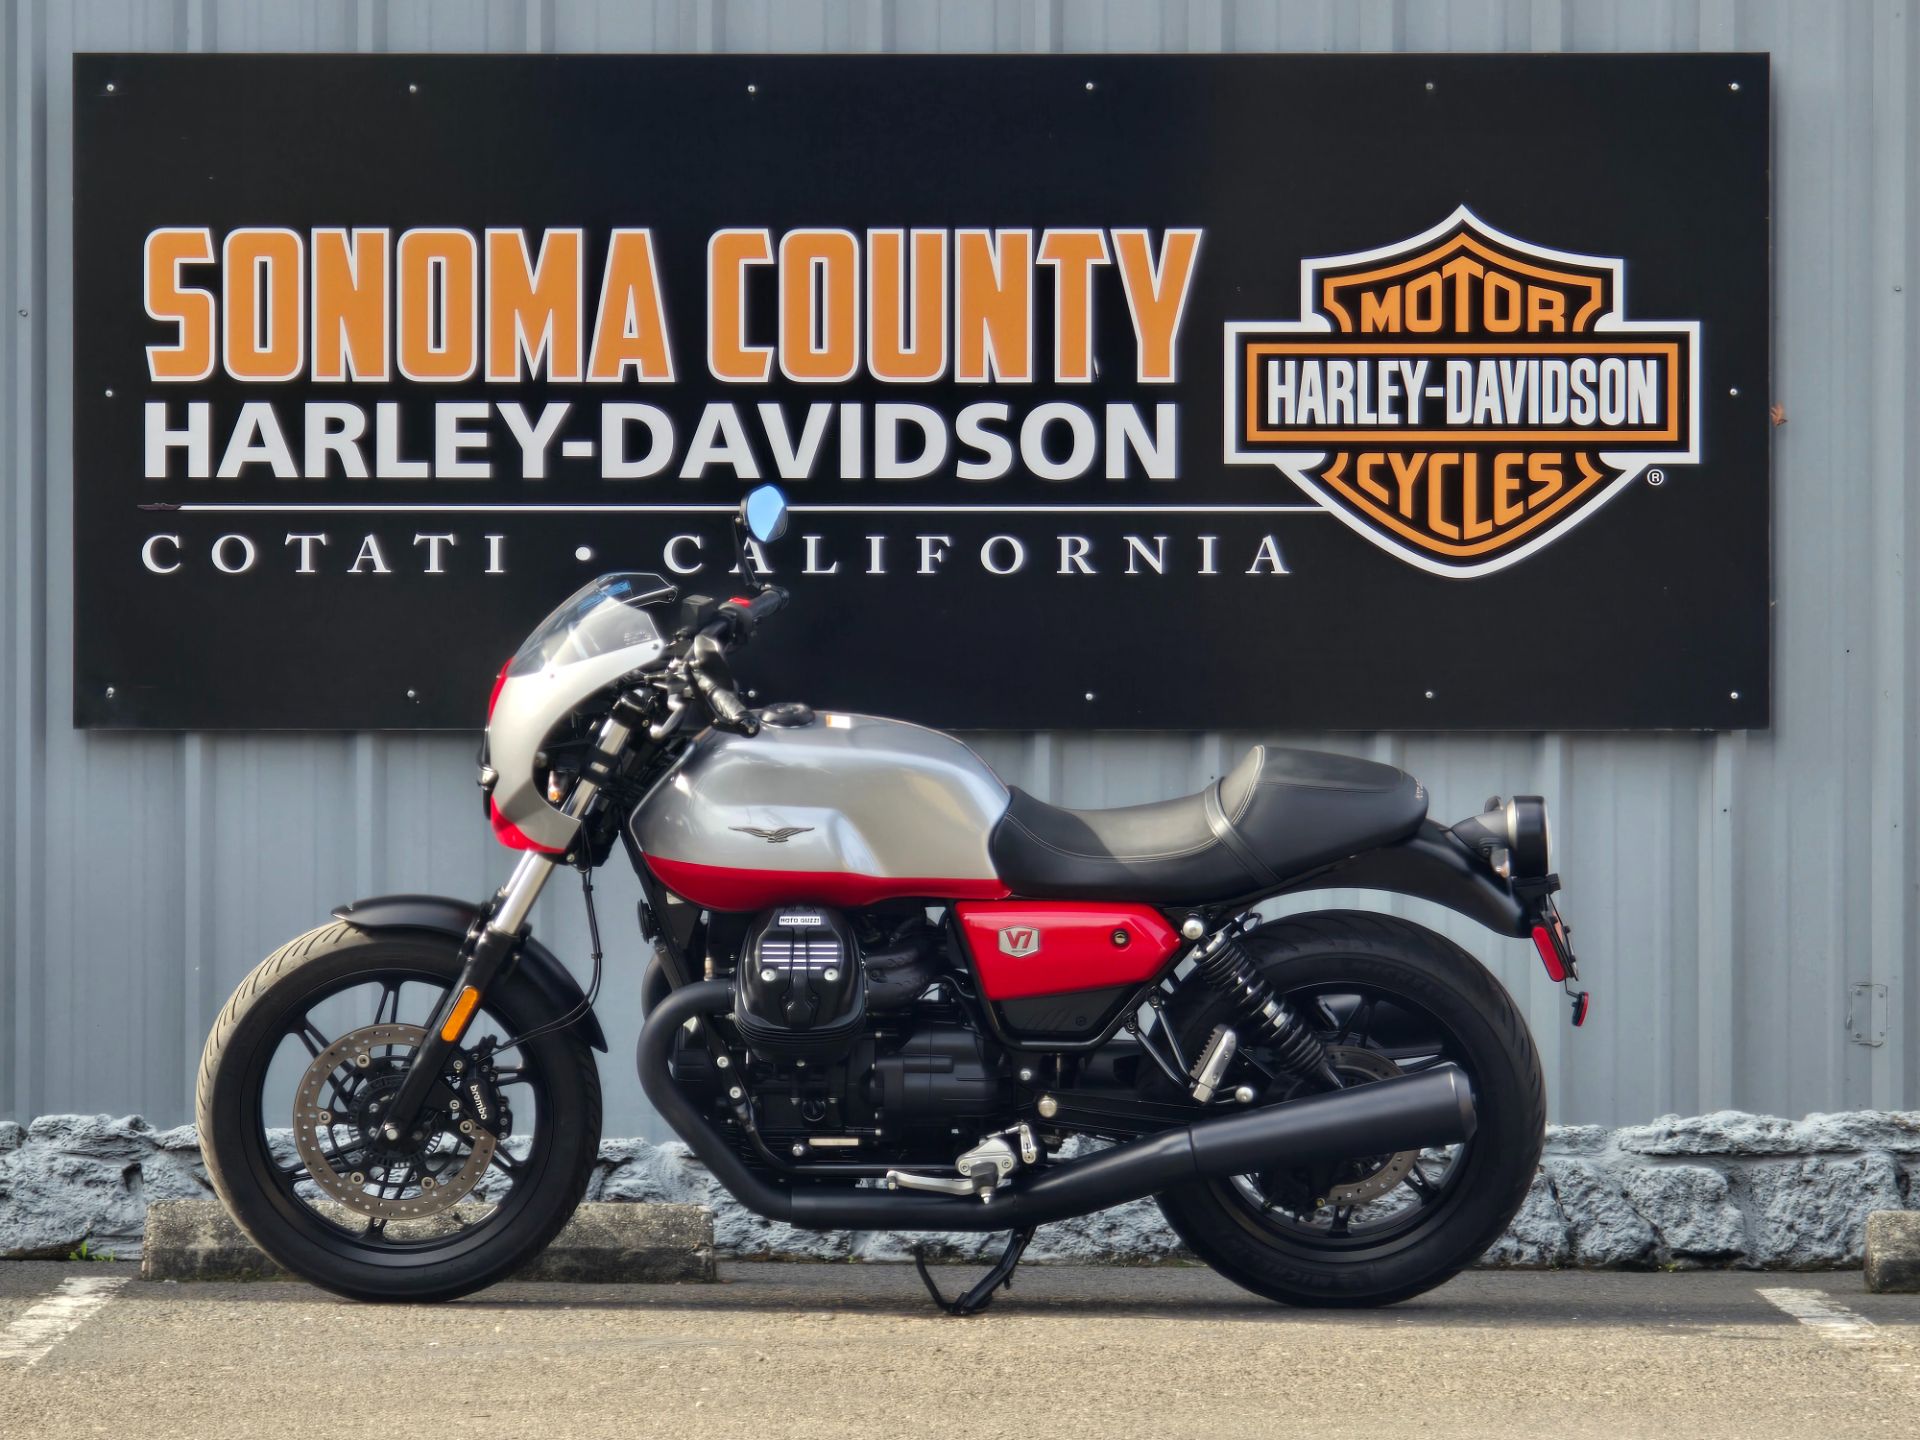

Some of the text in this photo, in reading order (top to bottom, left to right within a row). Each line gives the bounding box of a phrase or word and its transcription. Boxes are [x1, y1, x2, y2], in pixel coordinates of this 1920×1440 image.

[144, 227, 1203, 384] SONOMA COUNTY
[1360, 254, 1566, 333] MOTOR
[1267, 357, 1657, 426] HARLEY-DAVIDSON
[144, 402, 1178, 480] HARLEY-DAVIDSON
[1356, 452, 1564, 541] CYCLES
[141, 533, 1291, 575] COTATI CALIFORNIA
[1005, 930, 1033, 949] V7
[469, 1084, 488, 1120] brembo
